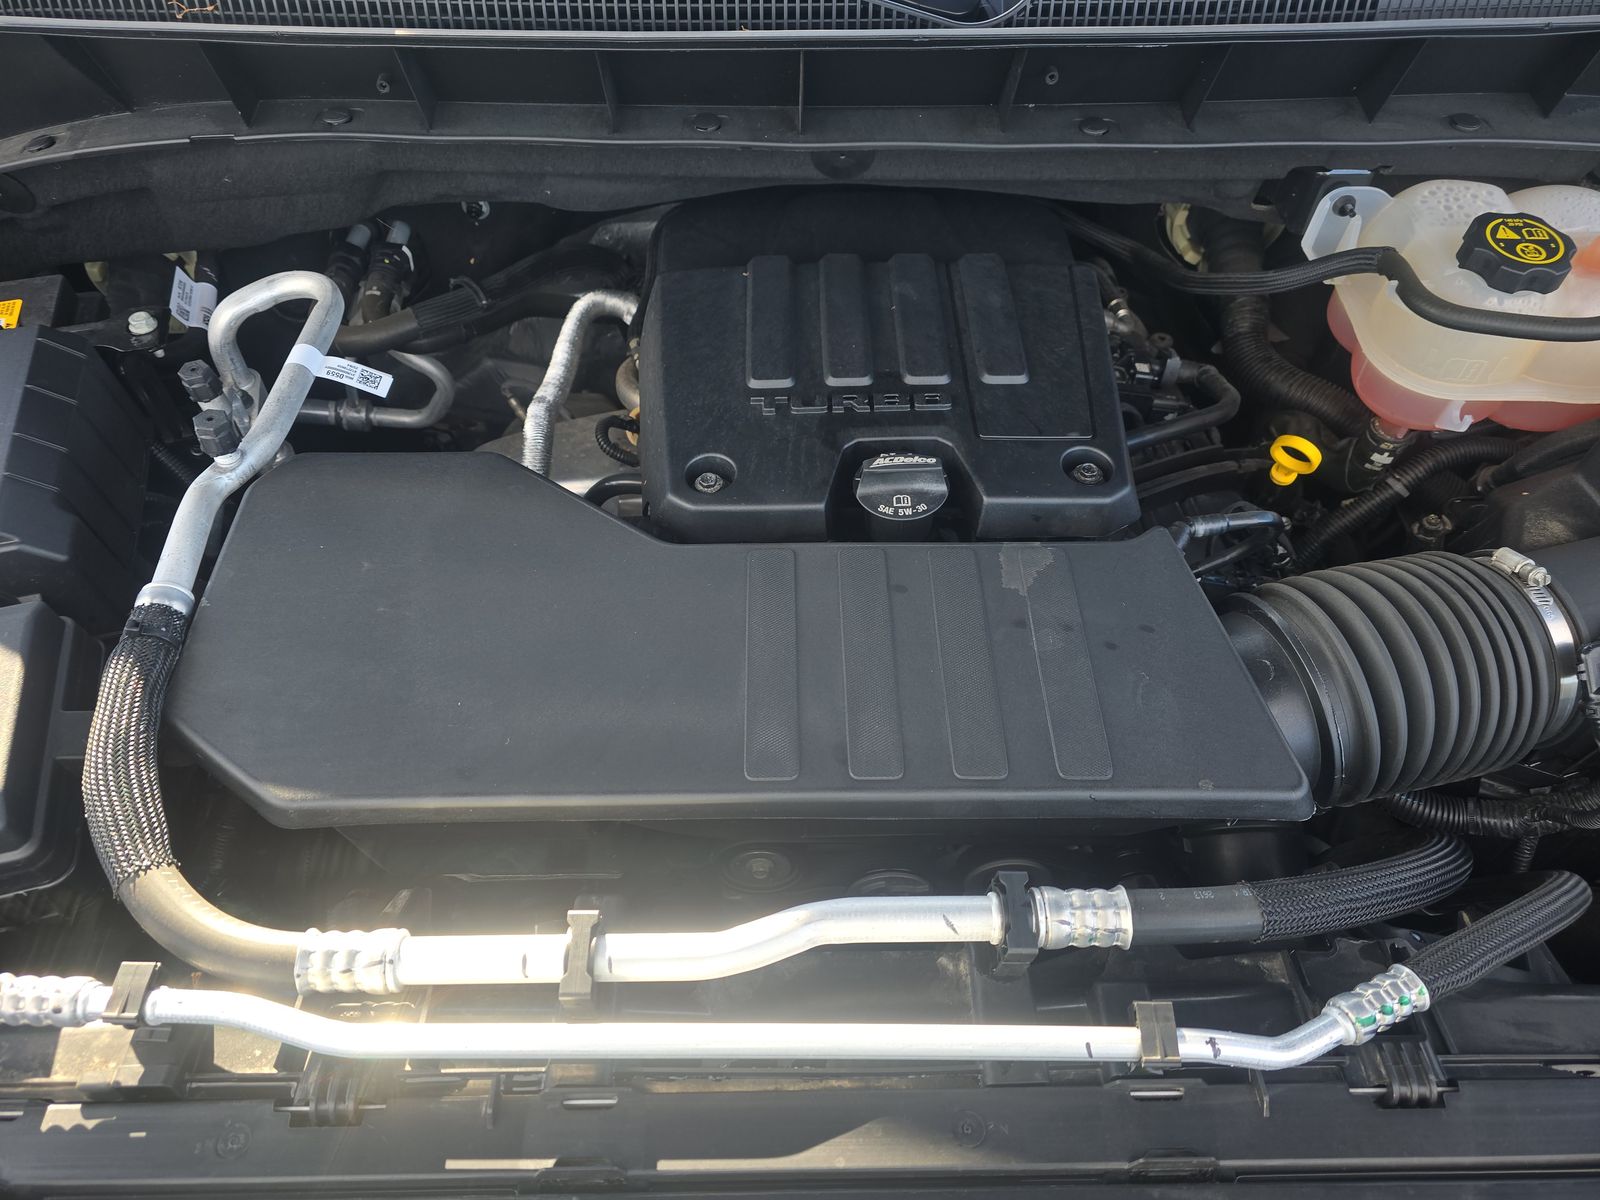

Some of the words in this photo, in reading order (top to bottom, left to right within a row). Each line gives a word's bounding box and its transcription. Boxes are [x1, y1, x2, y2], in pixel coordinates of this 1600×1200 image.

[326, 370, 345, 380] 0559
[750, 393, 952, 416] TURBO
[870, 455, 936, 467] ACDelco
[877, 504, 895, 516] SAE
[898, 503, 928, 516] 5W-30
